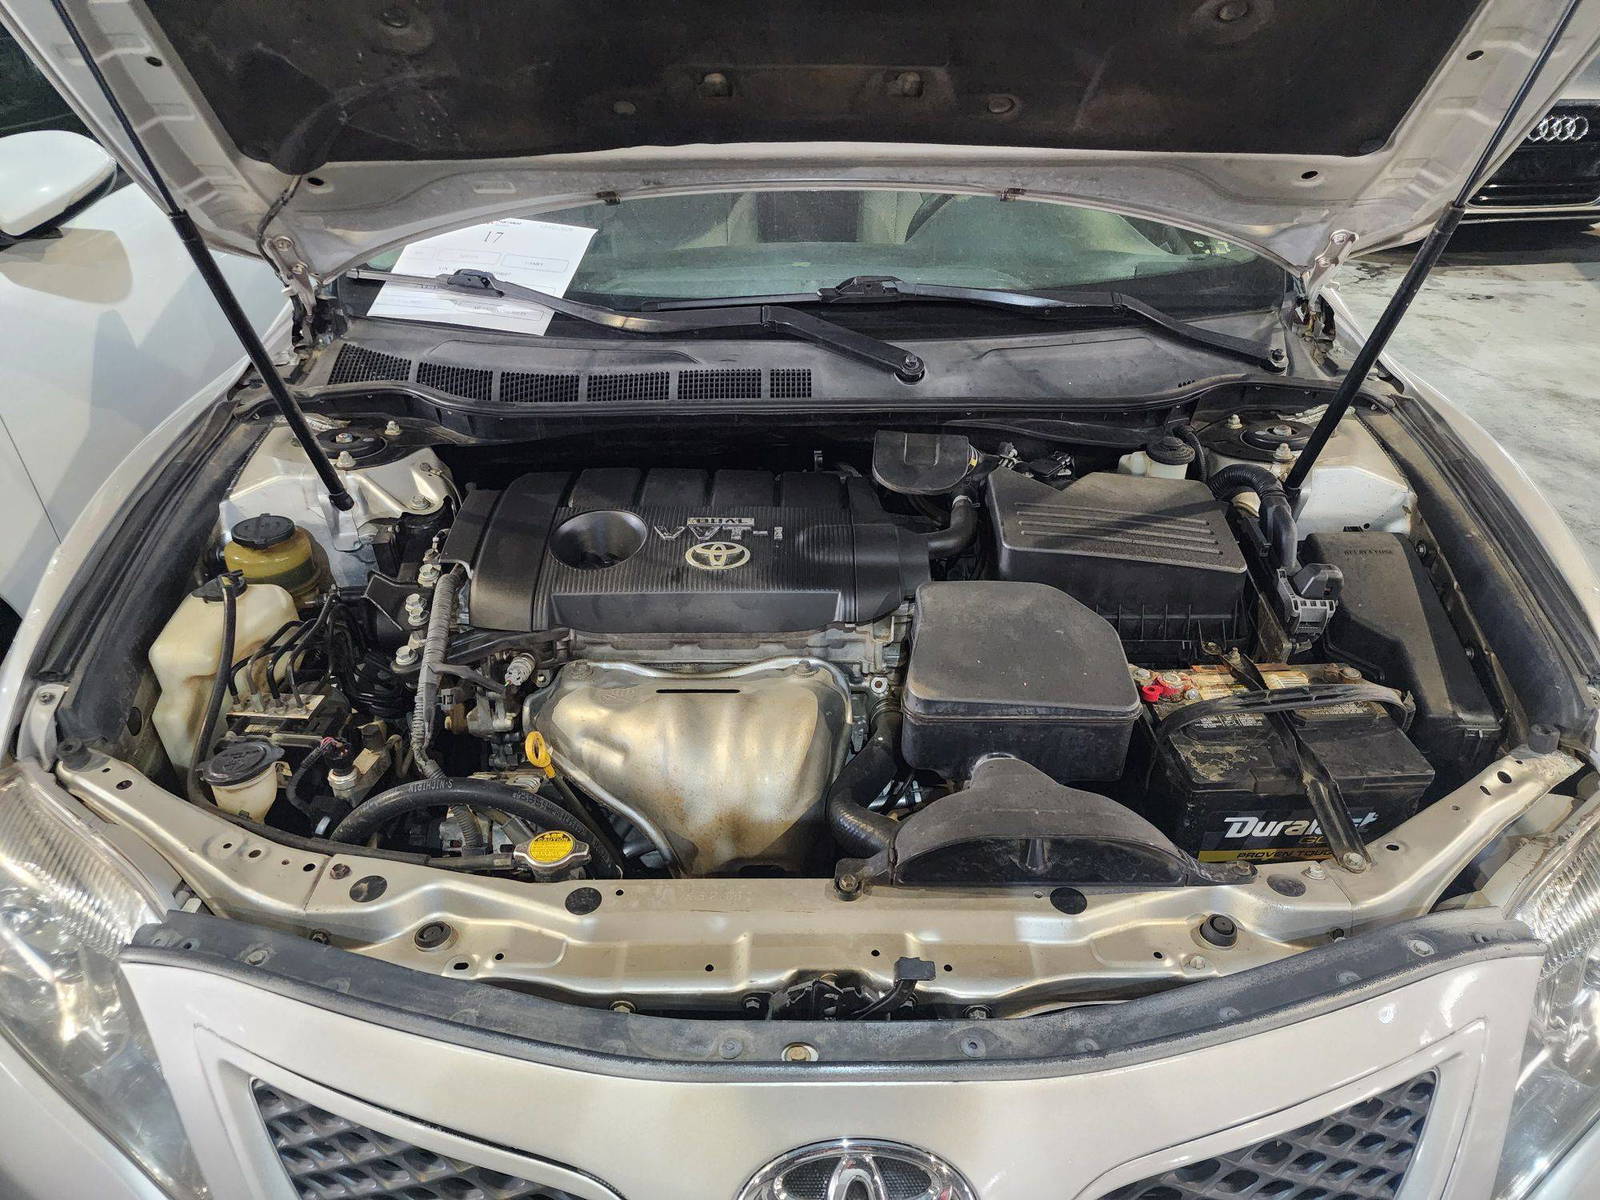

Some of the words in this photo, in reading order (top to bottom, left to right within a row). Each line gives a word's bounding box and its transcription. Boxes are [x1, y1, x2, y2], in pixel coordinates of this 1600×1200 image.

[484, 231, 504, 243] 17
[1236, 850, 1293, 860] PROVEN
[1296, 848, 1335, 858] TOUG
